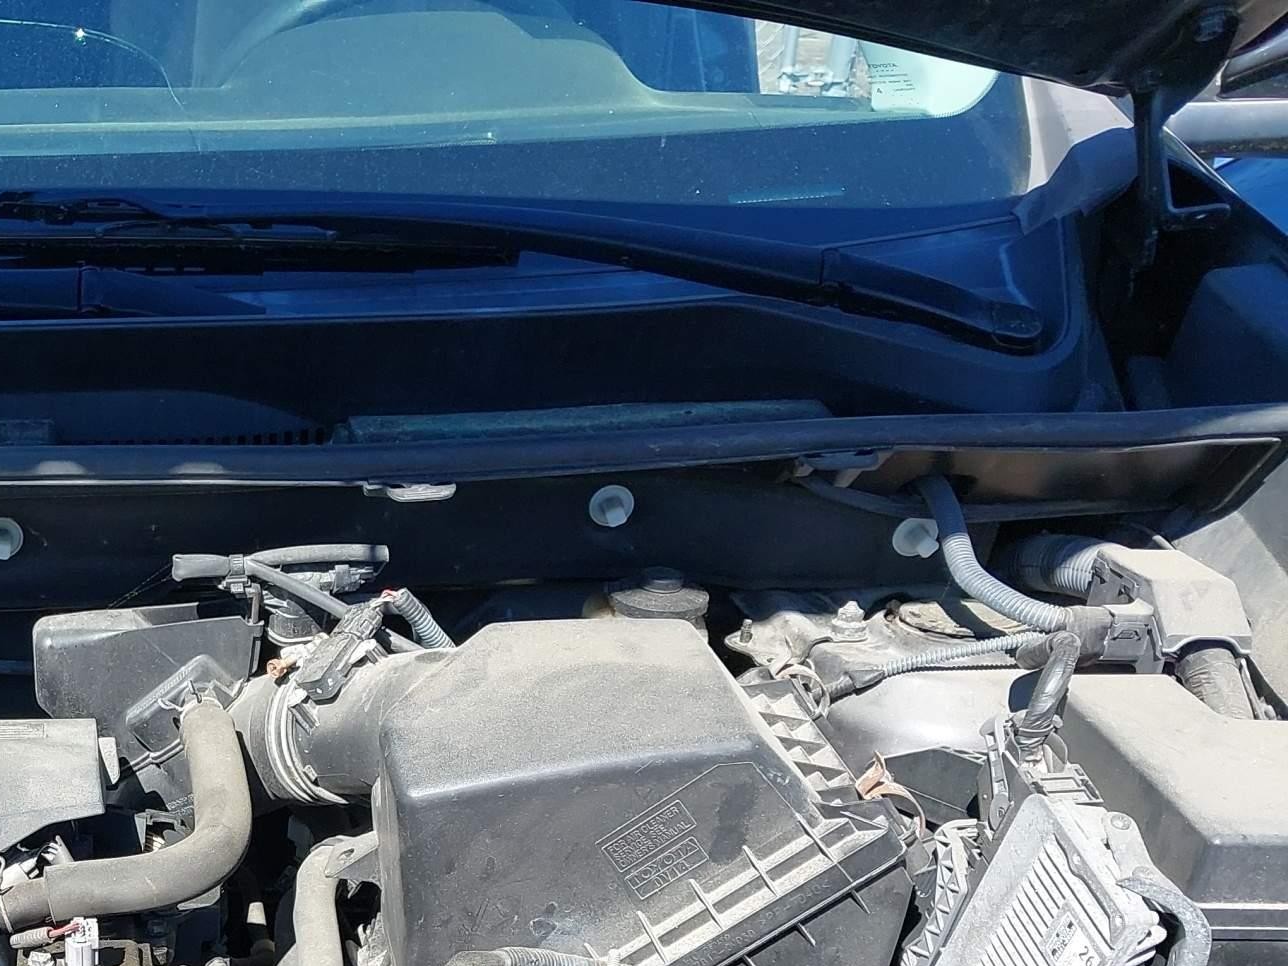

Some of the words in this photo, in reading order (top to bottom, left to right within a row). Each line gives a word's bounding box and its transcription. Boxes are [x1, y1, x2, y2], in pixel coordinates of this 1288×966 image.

[607, 840, 626, 852] FOR
[626, 830, 642, 843] AIR
[641, 806, 679, 833] CLEANER
[650, 825, 668, 838] SEE
[655, 821, 691, 845] MANUAL
[633, 840, 699, 884] TOYOTA
